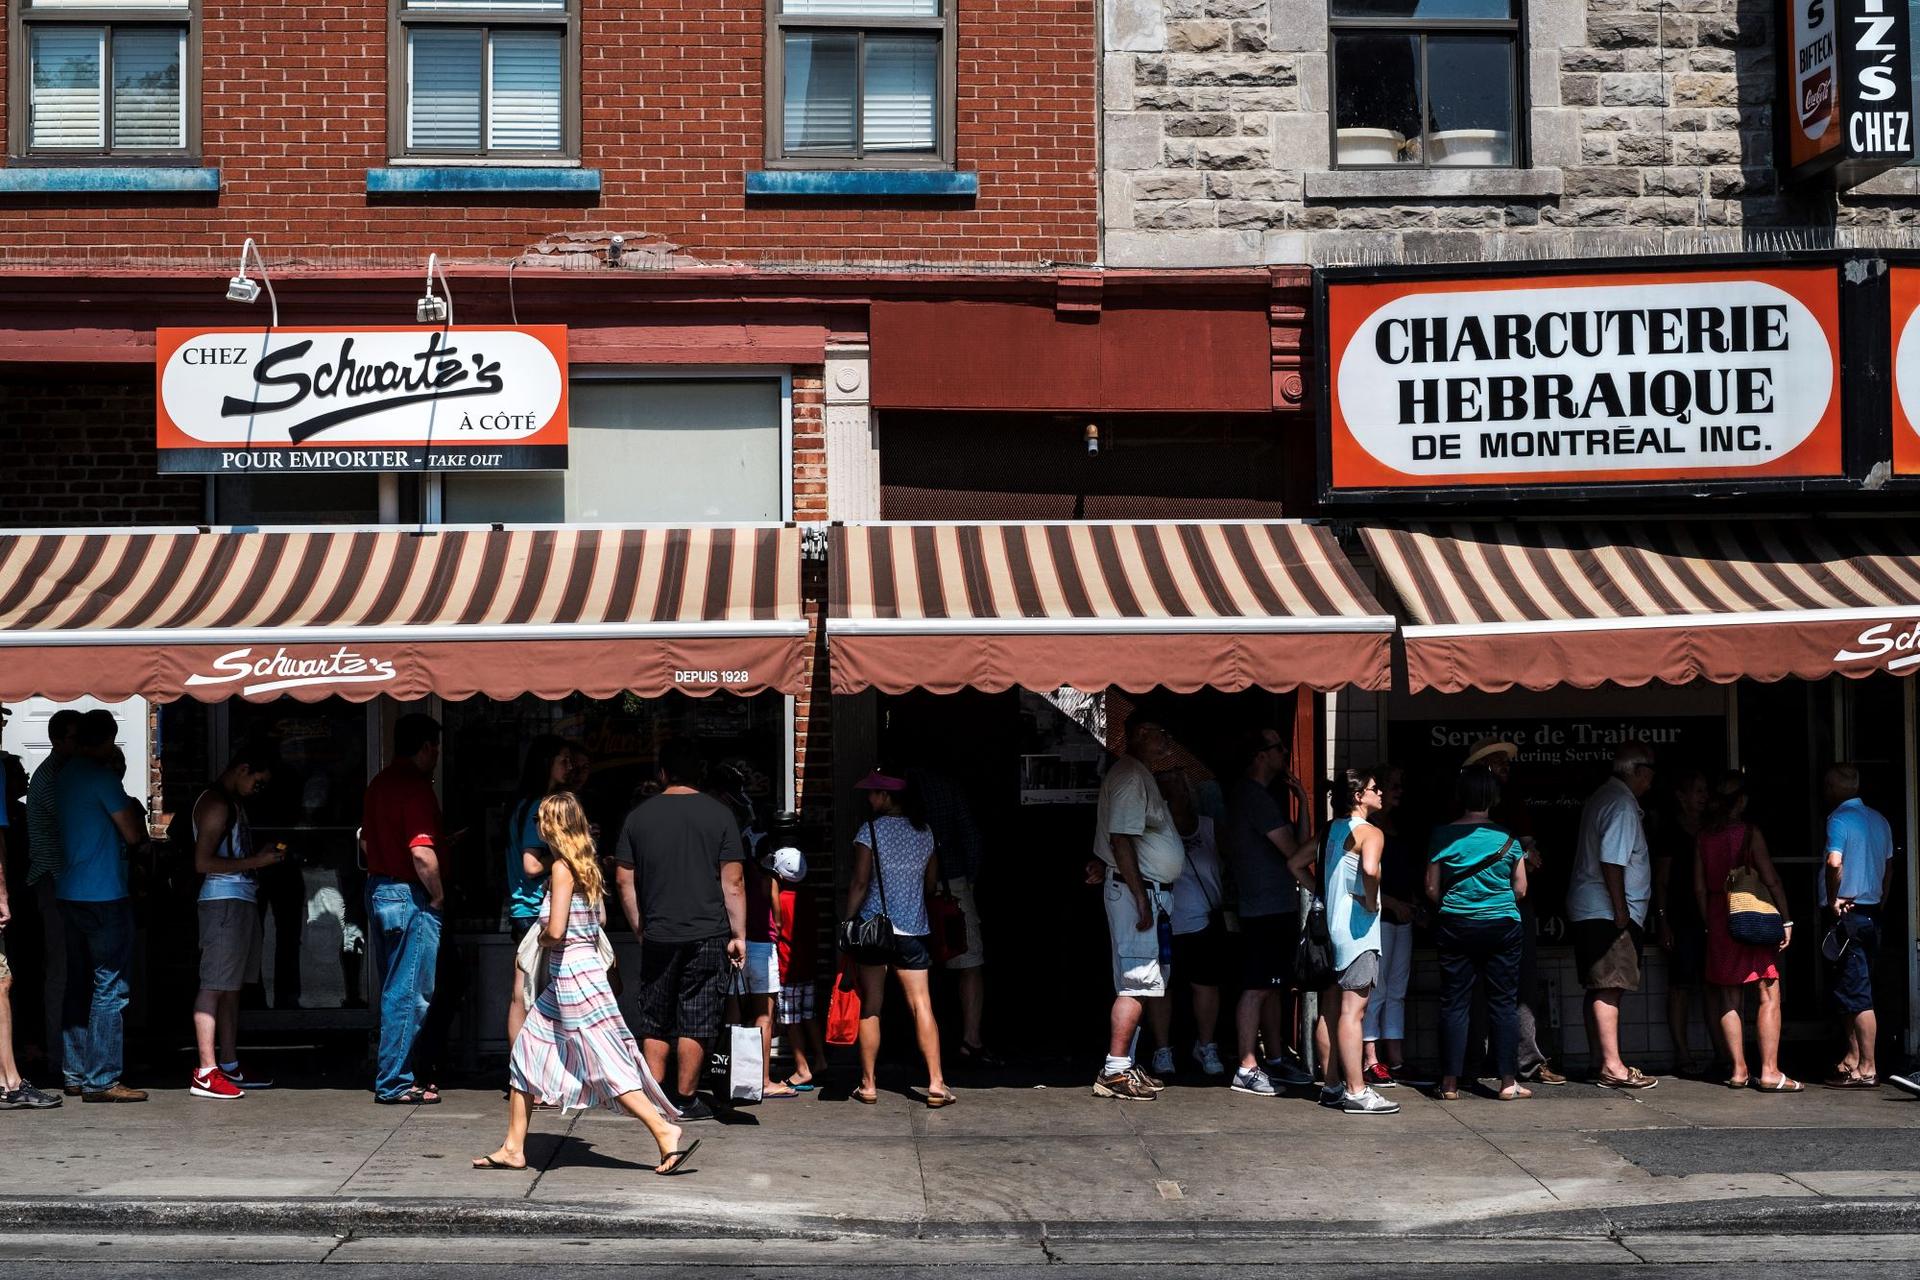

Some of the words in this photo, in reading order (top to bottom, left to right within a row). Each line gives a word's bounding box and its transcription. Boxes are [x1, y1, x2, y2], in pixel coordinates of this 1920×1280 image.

[1799, 31, 1834, 74] BIFTECK
[1849, 111, 1911, 153] CHEZ
[1375, 304, 1789, 365] CHARCUTERIE
[182, 347, 248, 365] CHEZ
[221, 332, 503, 445] Schwartz's
[1397, 367, 1774, 425] HEBRAIQUE
[459, 412, 474, 430] À
[479, 411, 536, 431] CÔTÉ
[221, 452, 283, 469] POUR
[289, 451, 409, 468] EMPORTER
[428, 455, 466, 467] TAKE
[470, 454, 503, 466] OUT
[1412, 433, 1461, 461] DE
[1480, 425, 1686, 459] MONTRÉAL
[1700, 425, 1772, 452] INC.
[184, 646, 397, 697] Schwartz's
[675, 670, 718, 683] DEPUIS
[720, 670, 749, 683] 1928
[1534, 724, 1565, 745] de
